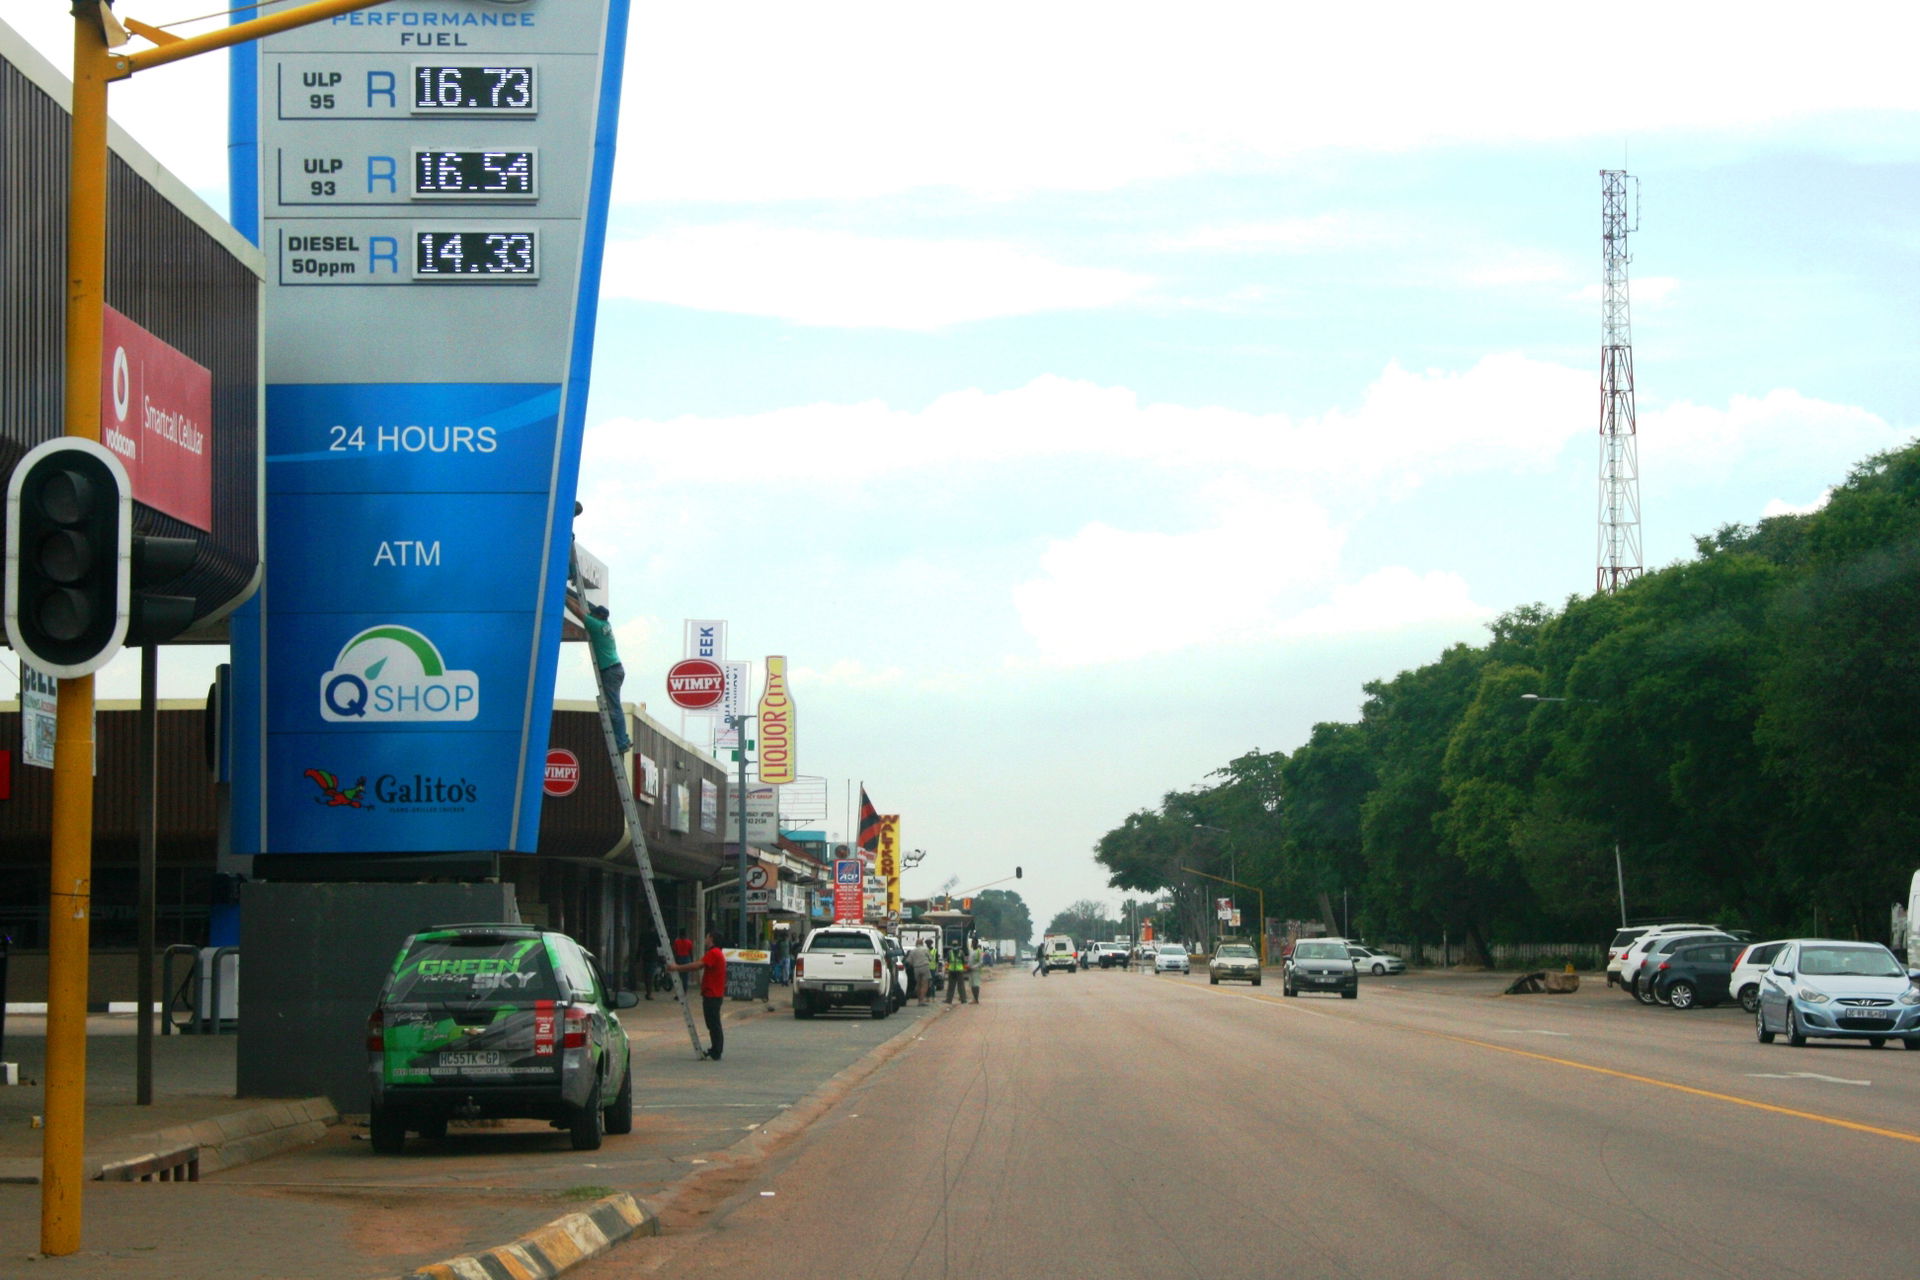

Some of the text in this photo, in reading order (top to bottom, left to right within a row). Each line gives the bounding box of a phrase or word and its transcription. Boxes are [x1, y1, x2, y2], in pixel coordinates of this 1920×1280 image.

[332, 12, 536, 27] PERFORMANCE
[401, 32, 467, 46] FUEL
[303, 72, 342, 87] ULP
[367, 67, 530, 108] R 16.73
[310, 95, 335, 110] 95
[304, 159, 343, 174] ULP
[367, 153, 528, 193] R 16.54
[311, 181, 336, 196] 93
[288, 236, 359, 251] DIESEL
[369, 234, 532, 274] R 14.33
[292, 259, 355, 277] 50ppm
[144, 394, 203, 455] Smartcall Cellular
[329, 425, 498, 454] 24 HOURS
[373, 541, 441, 566] ATM
[669, 677, 722, 691] WIMPY
[763, 673, 788, 777] LIQUOR CITY
[375, 774, 477, 803] Galito's
[418, 959, 520, 974] GREEN
[472, 972, 537, 989] SKY
[536, 1044, 553, 1054] 3M
